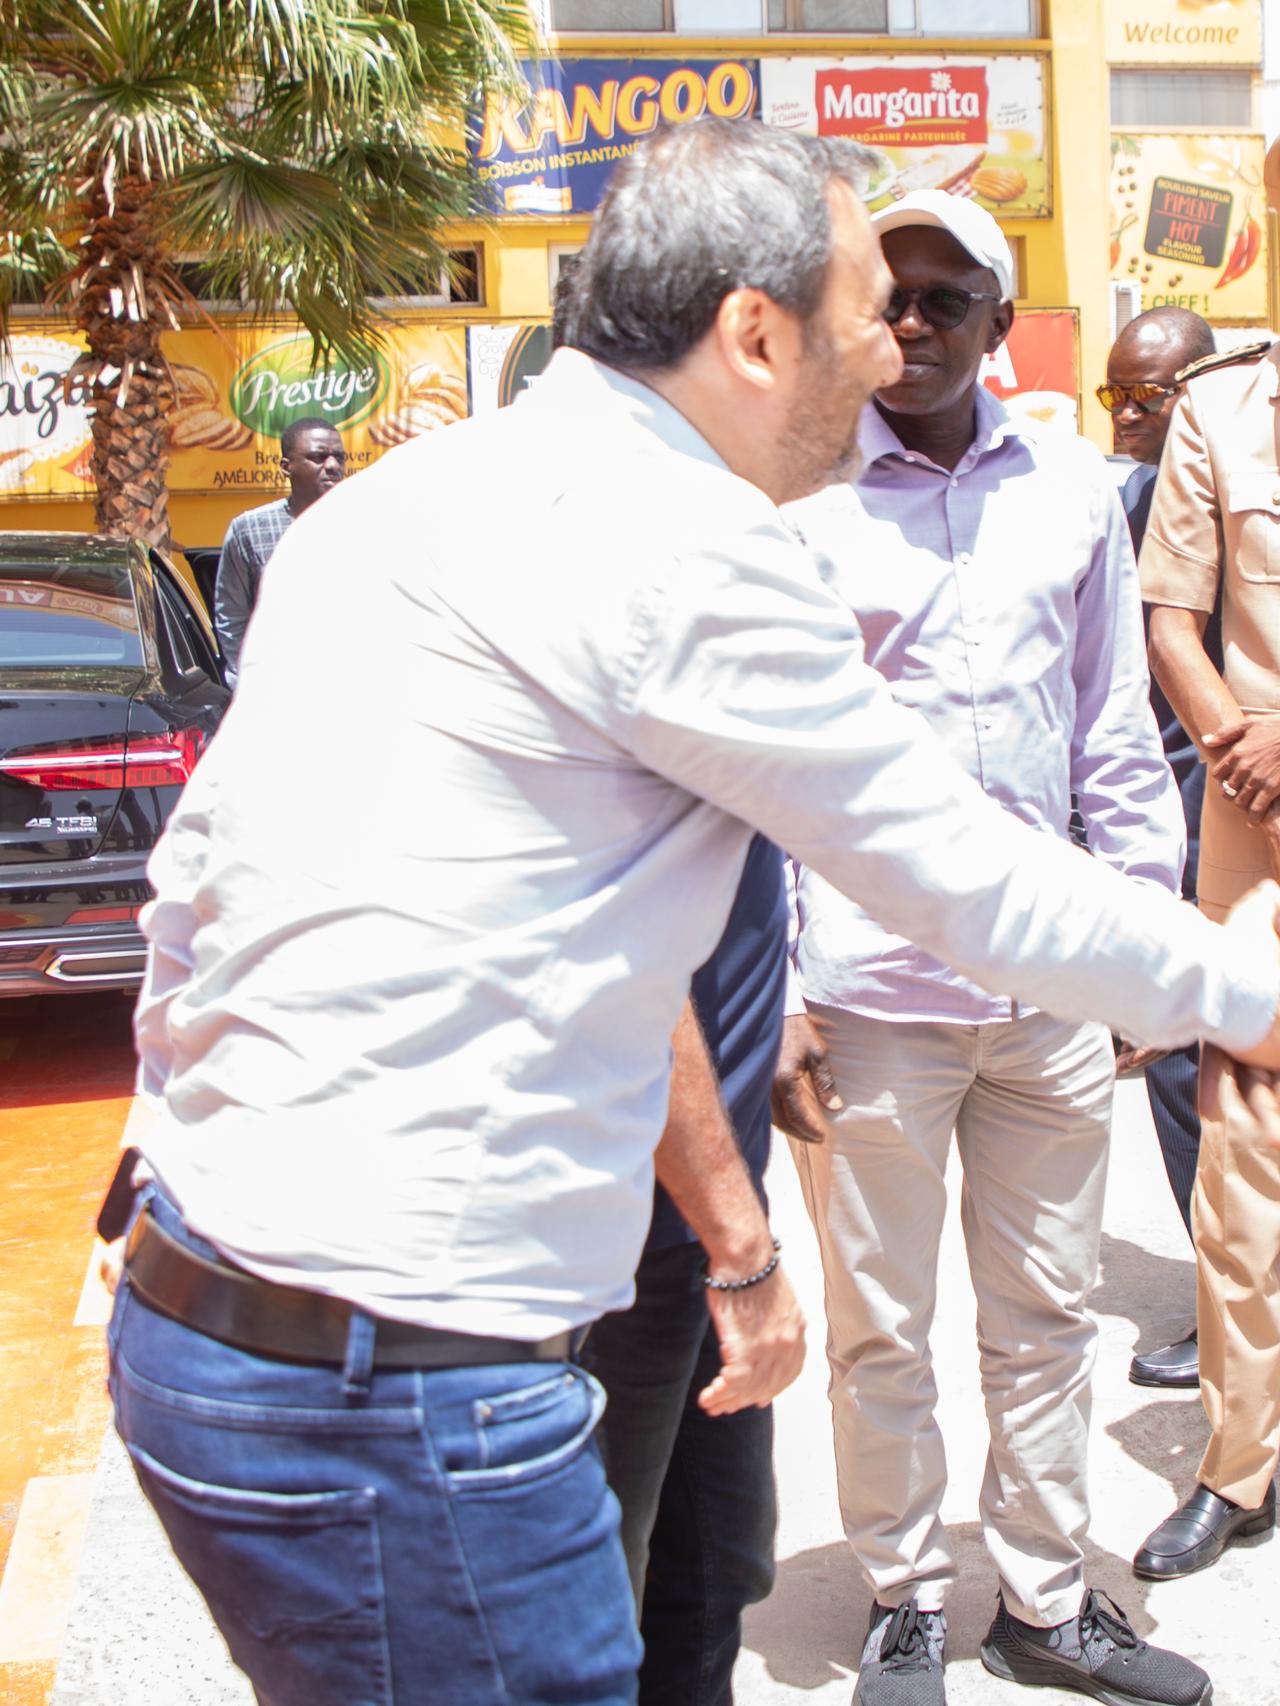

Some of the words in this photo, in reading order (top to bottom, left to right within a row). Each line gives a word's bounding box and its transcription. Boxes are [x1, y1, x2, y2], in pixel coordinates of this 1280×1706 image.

[1124, 22, 1240, 44] Welcome
[476, 61, 755, 160] KANGOO
[824, 82, 980, 128] Margarita
[477, 156, 547, 181] BOISSON
[1163, 191, 1219, 225] PIMENT
[1169, 220, 1203, 243] HOT
[242, 365, 376, 416] Prestige
